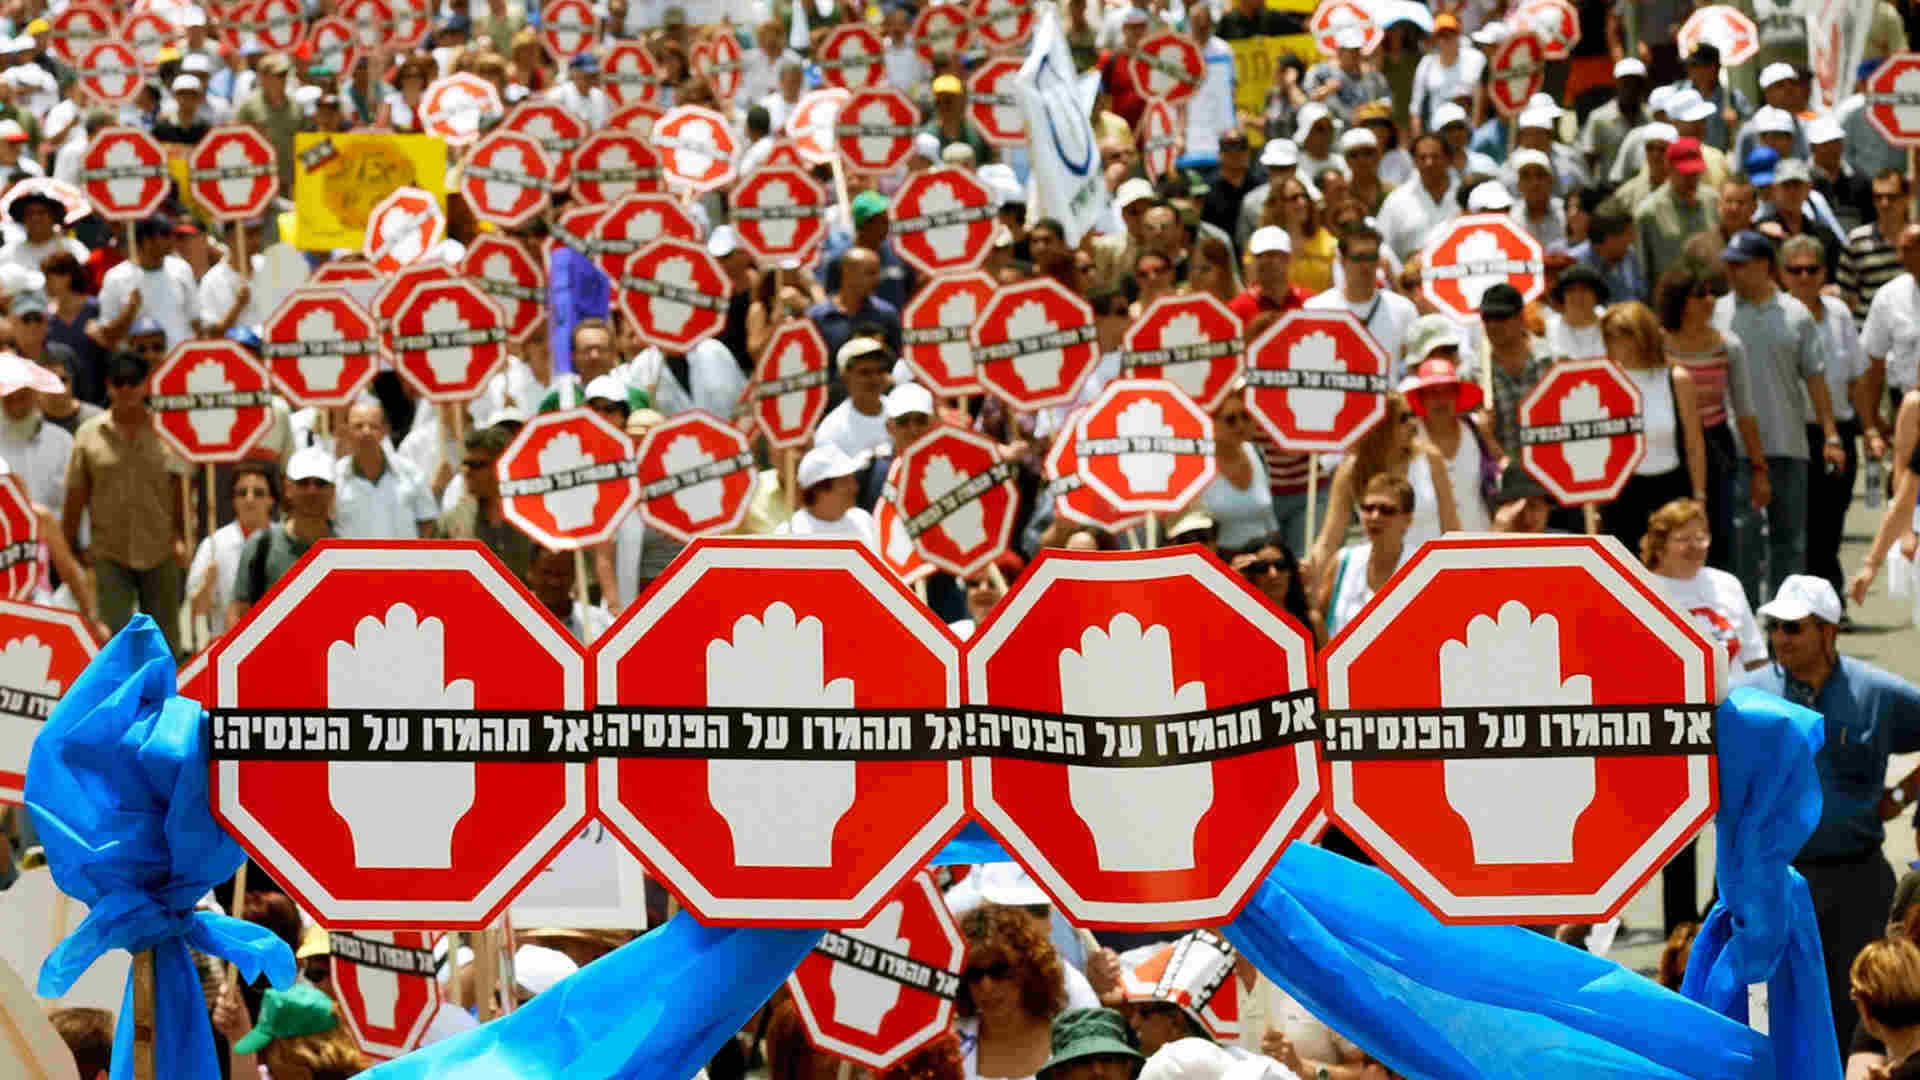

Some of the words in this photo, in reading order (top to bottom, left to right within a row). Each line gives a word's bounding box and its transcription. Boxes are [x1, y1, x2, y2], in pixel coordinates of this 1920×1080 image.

[213, 715, 350, 751] הפנסיה!
[363, 714, 409, 752] על
[423, 717, 531, 752] תהמרו
[543, 715, 590, 752] אל
[592, 712, 729, 749] הפנסיה!
[742, 712, 789, 750] על
[802, 715, 912, 751] תהמרו
[965, 711, 1086, 756] הפנסיה!
[1155, 708, 1263, 757] תהמרו
[1271, 696, 1317, 737] אל
[1325, 715, 1465, 751] הפנסיה!
[1478, 711, 1525, 750] על
[1539, 711, 1650, 748] תהמרו
[1664, 709, 1712, 745] אל
[1096, 720, 1143, 758] על
[852, 941, 877, 968] על
[878, 951, 932, 987] תהמרו
[935, 970, 961, 996] אל
